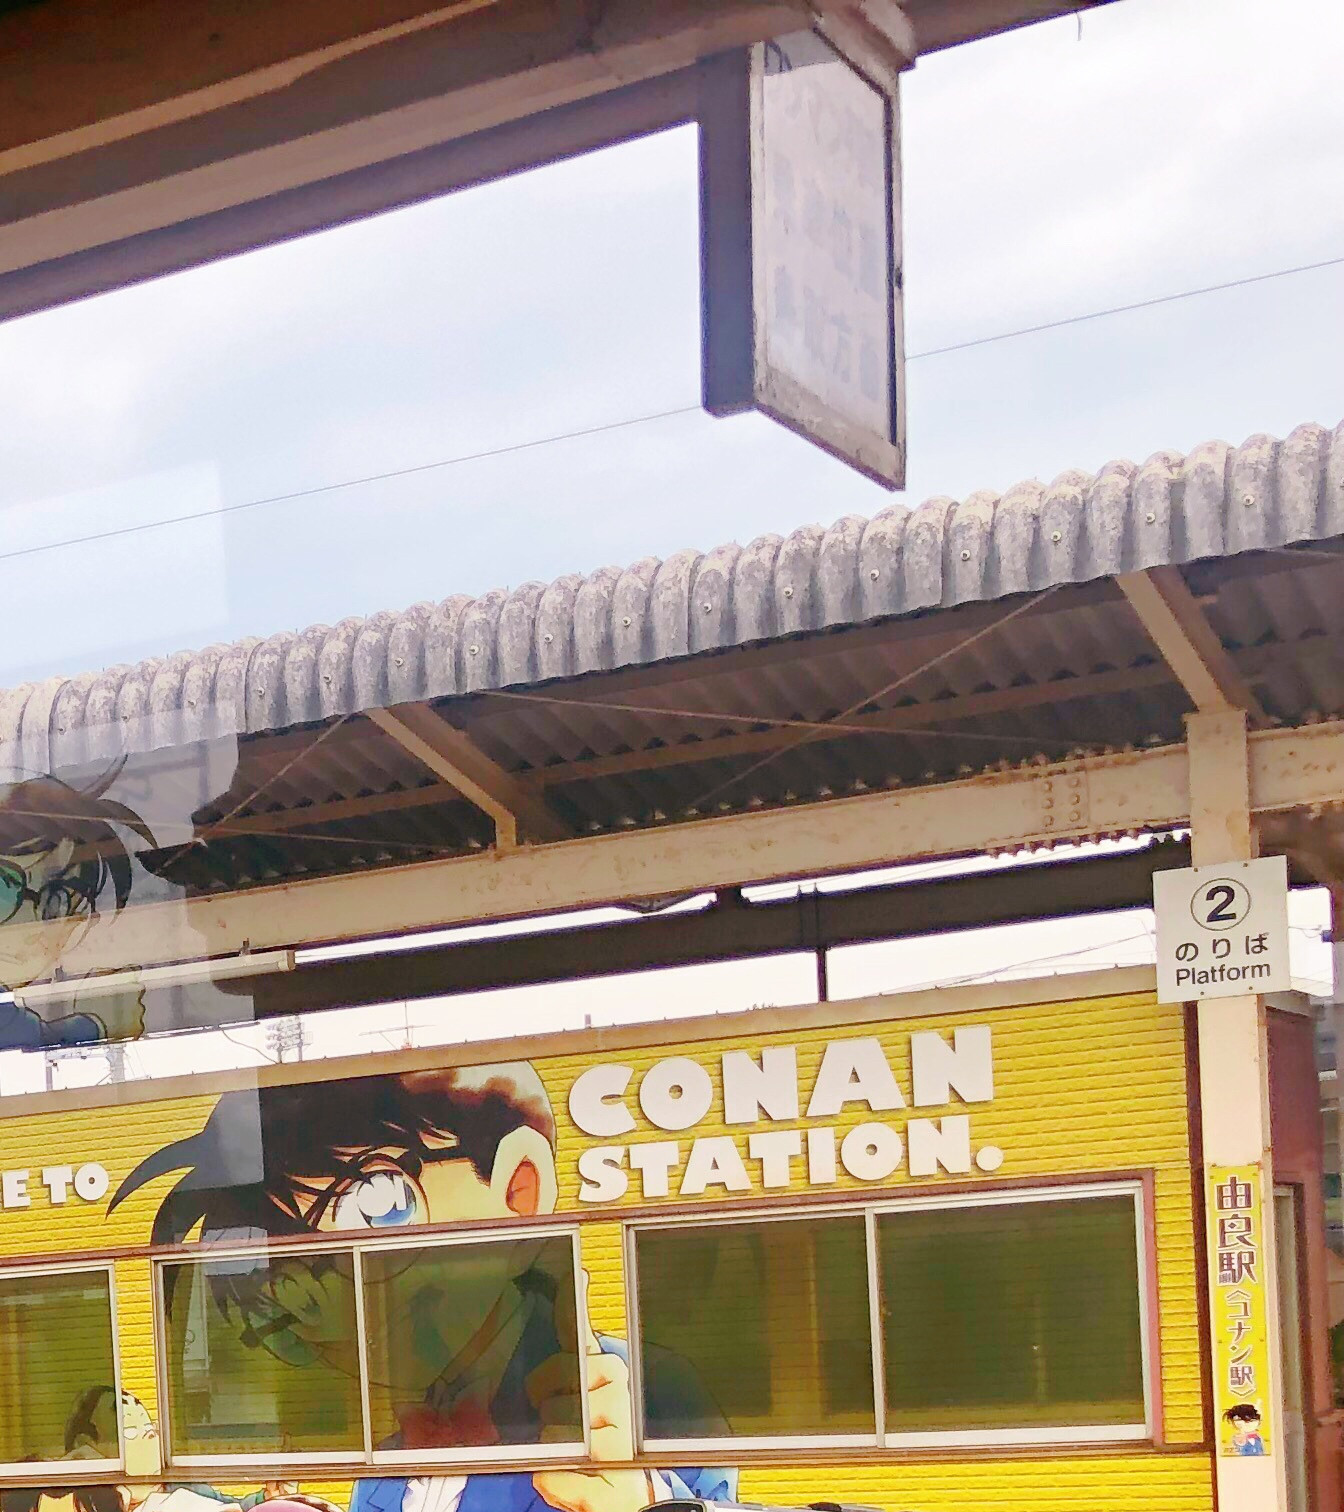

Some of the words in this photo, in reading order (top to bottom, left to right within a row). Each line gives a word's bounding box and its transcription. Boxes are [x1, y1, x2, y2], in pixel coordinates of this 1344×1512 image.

[1175, 932, 1270, 962] のりば
[1175, 963, 1271, 987] Platform
[568, 1025, 995, 1137] CONAN
[578, 1114, 1004, 1202] STATION.
[41, 1162, 110, 1205] TO
